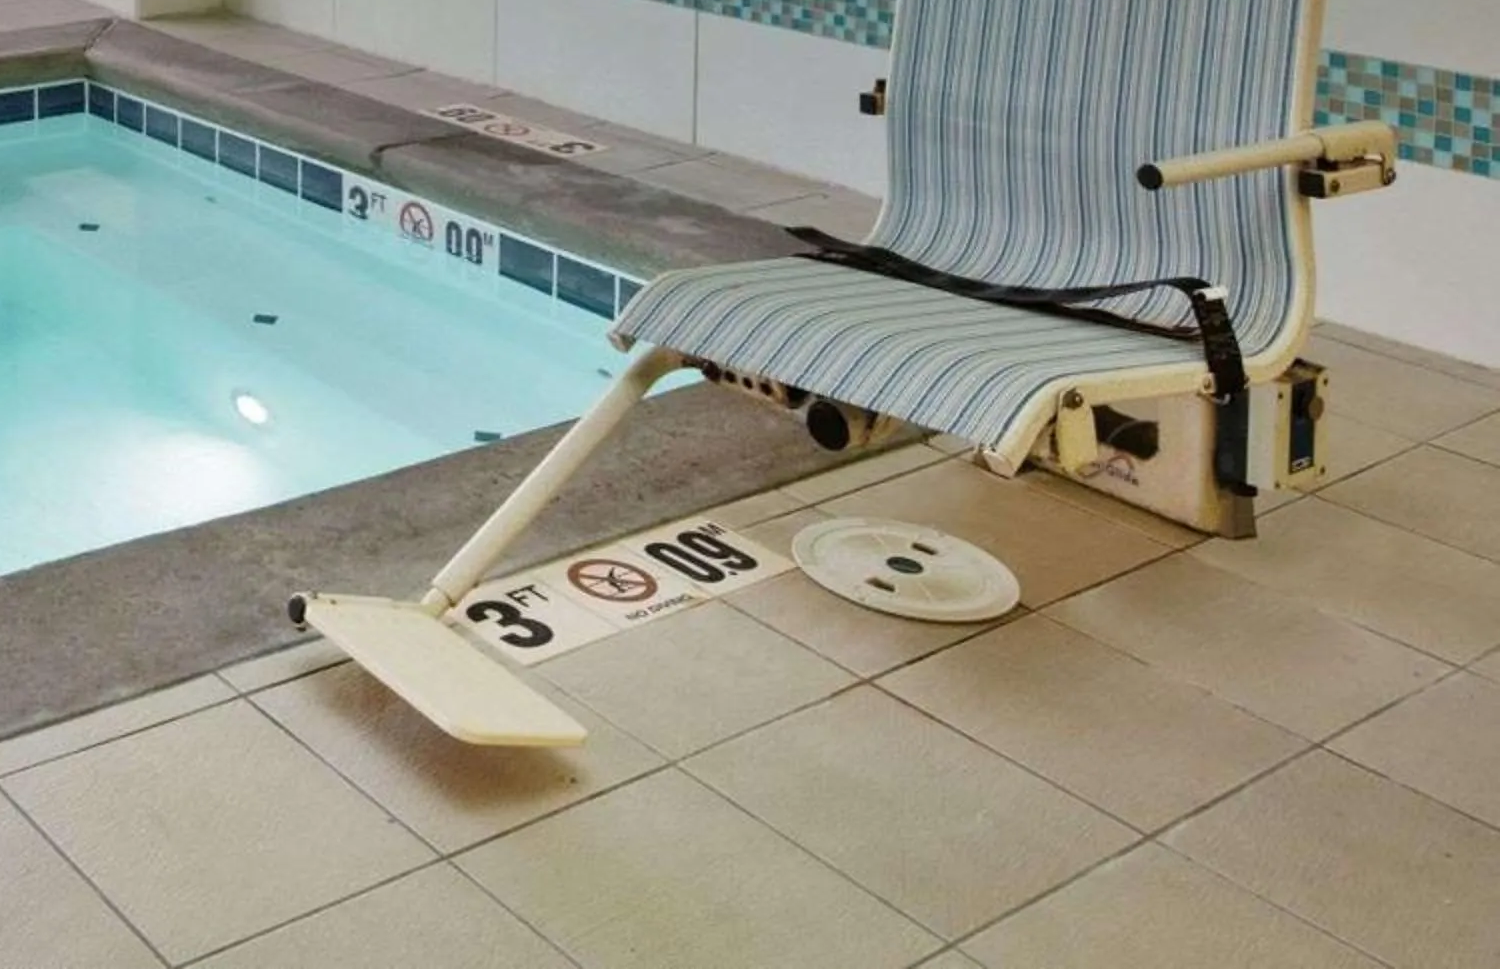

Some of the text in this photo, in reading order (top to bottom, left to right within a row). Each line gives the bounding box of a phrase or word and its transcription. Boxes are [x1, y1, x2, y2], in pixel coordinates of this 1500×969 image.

[371, 193, 387, 213] FT
[507, 584, 549, 612] FT
[466, 600, 554, 648] 3
